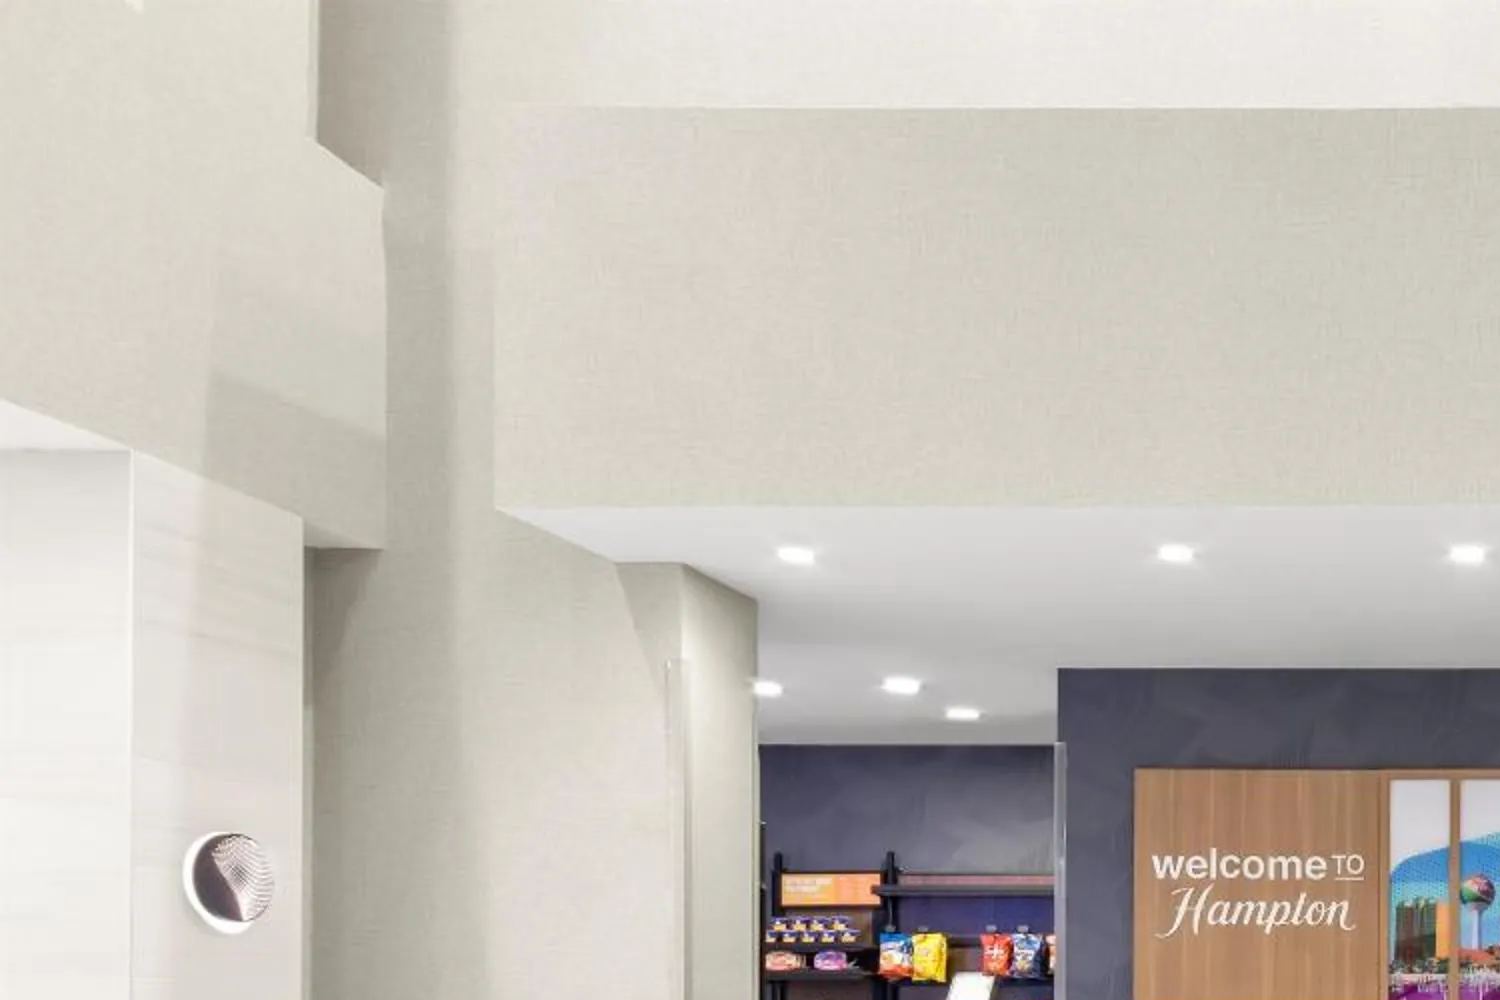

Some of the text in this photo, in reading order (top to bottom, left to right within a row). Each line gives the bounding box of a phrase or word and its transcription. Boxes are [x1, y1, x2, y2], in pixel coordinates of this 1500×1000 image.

[1151, 847, 1365, 881] welcome TO
[1154, 883, 1357, 939] Hampton
